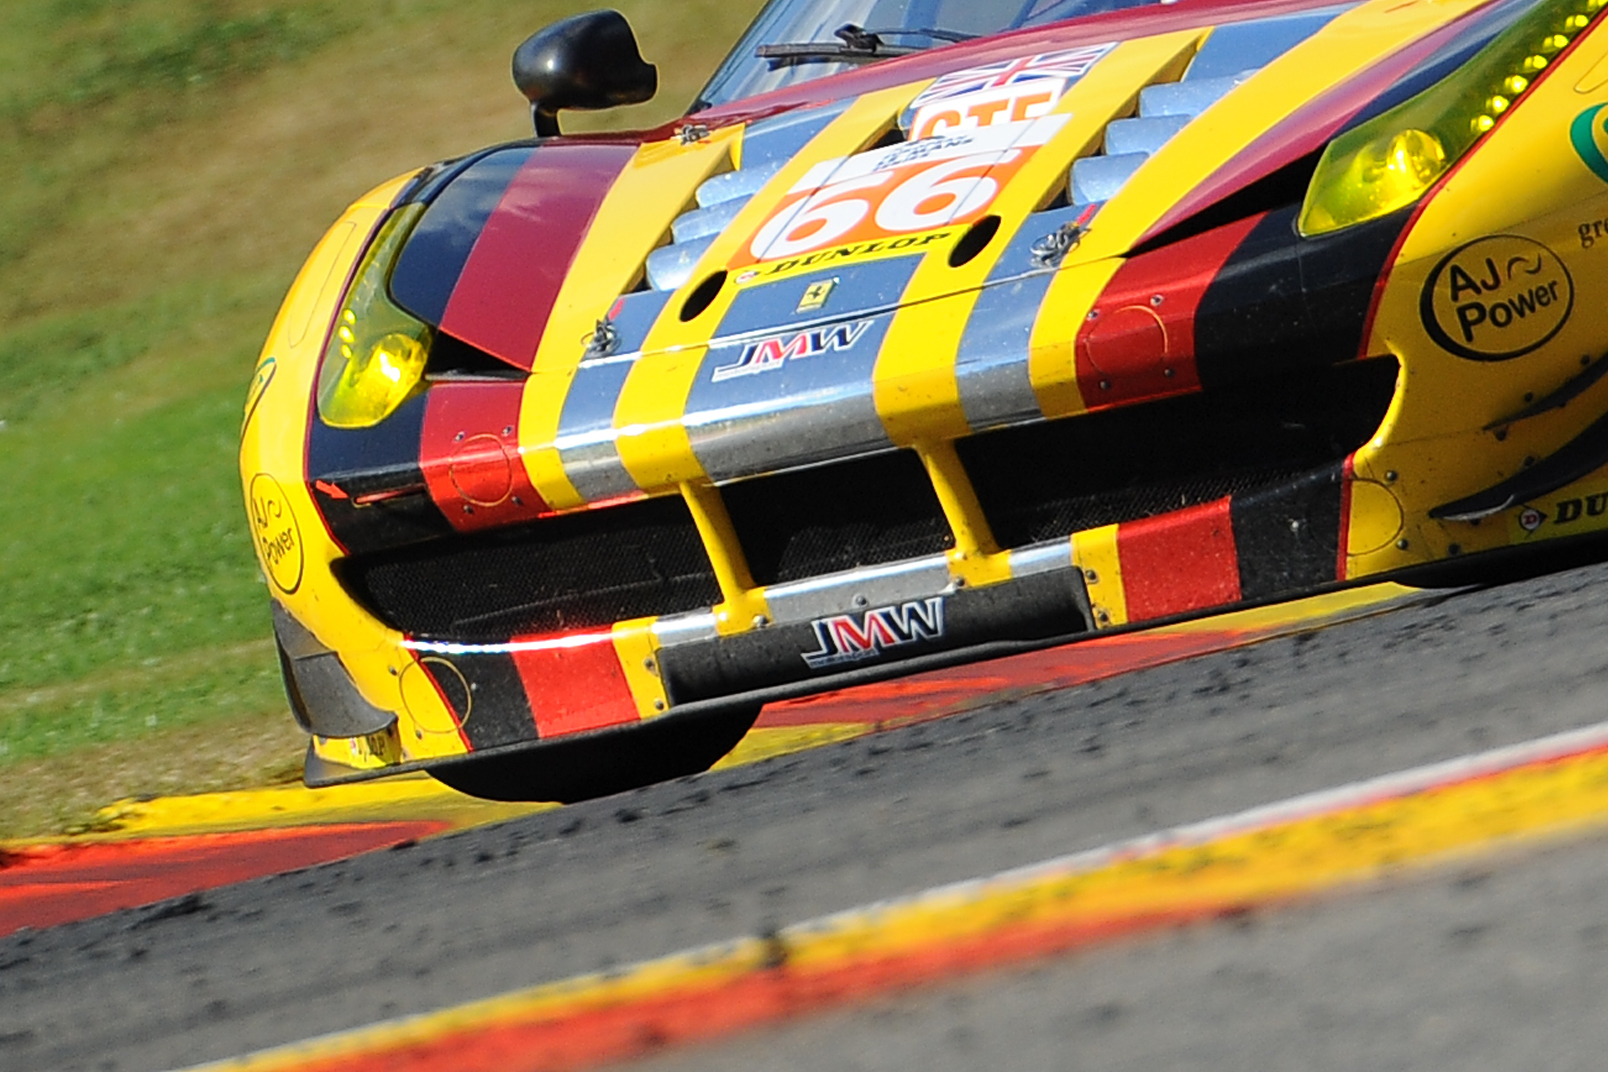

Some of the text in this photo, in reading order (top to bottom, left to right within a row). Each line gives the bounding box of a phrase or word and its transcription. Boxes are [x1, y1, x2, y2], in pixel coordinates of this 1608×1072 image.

[750, 148, 1021, 259] 66
[763, 232, 951, 275] DUNLOP
[1449, 258, 1500, 302] AJ
[1457, 278, 1558, 343] Power
[714, 320, 874, 374] JMW
[801, 597, 944, 661] JMW
